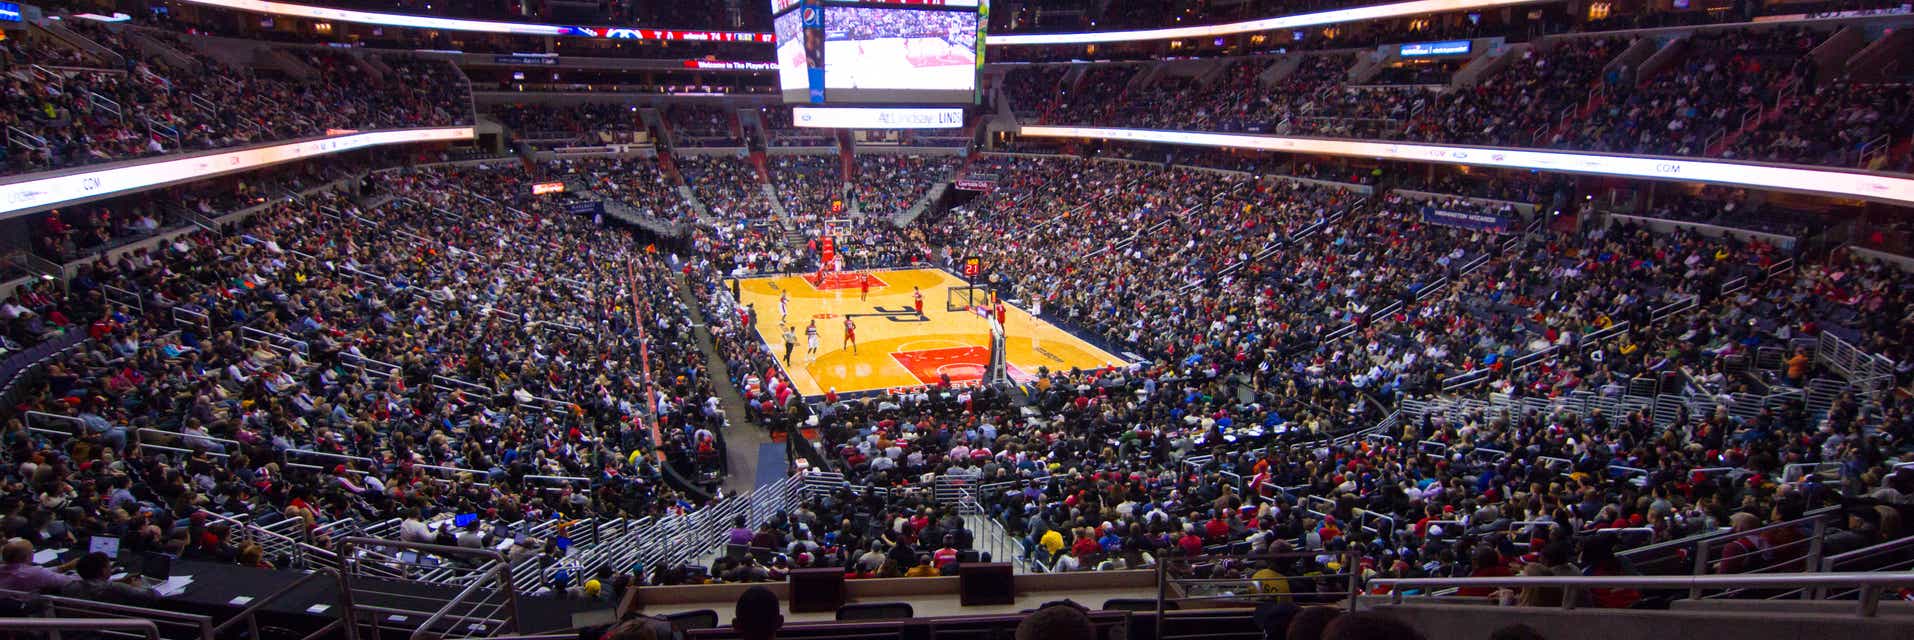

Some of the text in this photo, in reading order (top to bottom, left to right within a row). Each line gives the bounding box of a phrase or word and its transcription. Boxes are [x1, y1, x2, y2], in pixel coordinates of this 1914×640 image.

[733, 61, 745, 69] The
[1434, 210, 1496, 223] WASHINGTON WIZARDS
[966, 264, 978, 274] 21
